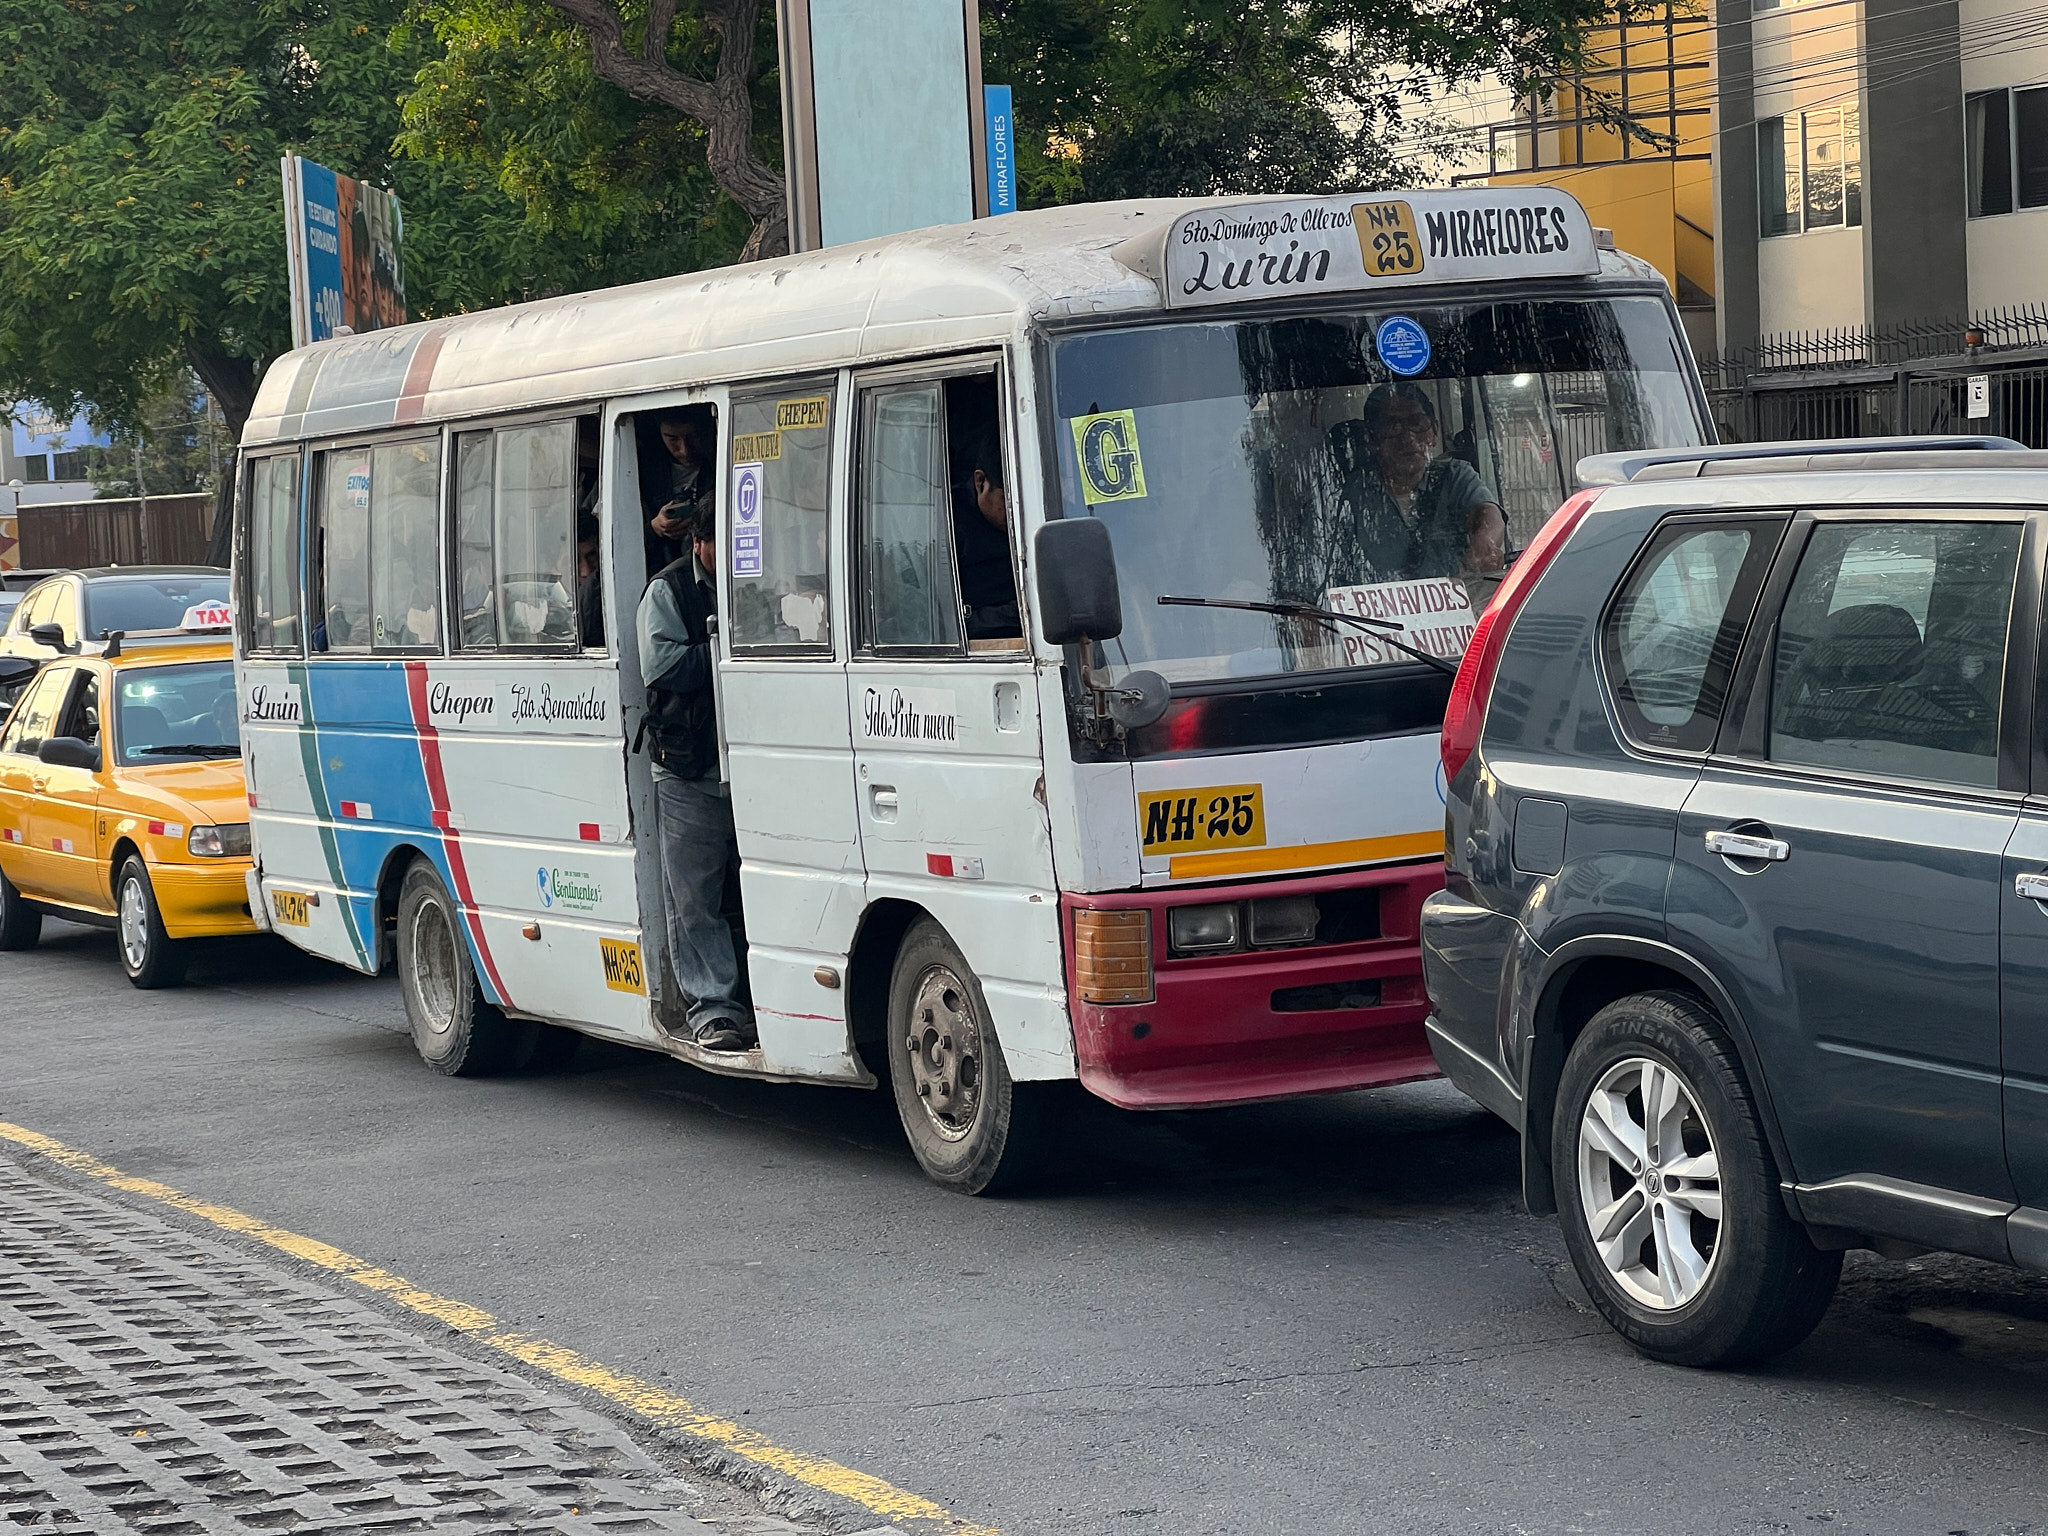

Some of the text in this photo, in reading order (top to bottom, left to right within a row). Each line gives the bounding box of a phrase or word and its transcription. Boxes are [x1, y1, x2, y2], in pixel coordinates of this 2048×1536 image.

[994, 115, 1009, 206] MIRAFLORES
[1301, 206, 1352, 231] Olleros
[1365, 204, 1400, 230] NH
[1425, 206, 1569, 258] MIRAFLORES
[1373, 231, 1414, 272] 25
[315, 286, 341, 327] +800
[777, 401, 825, 427] CHEPEN
[734, 432, 779, 461] PISTA NUEVA
[1081, 417, 1138, 497] G
[195, 609, 231, 624] TAX
[1344, 631, 1411, 665] PISTA
[430, 682, 495, 724] Chepen
